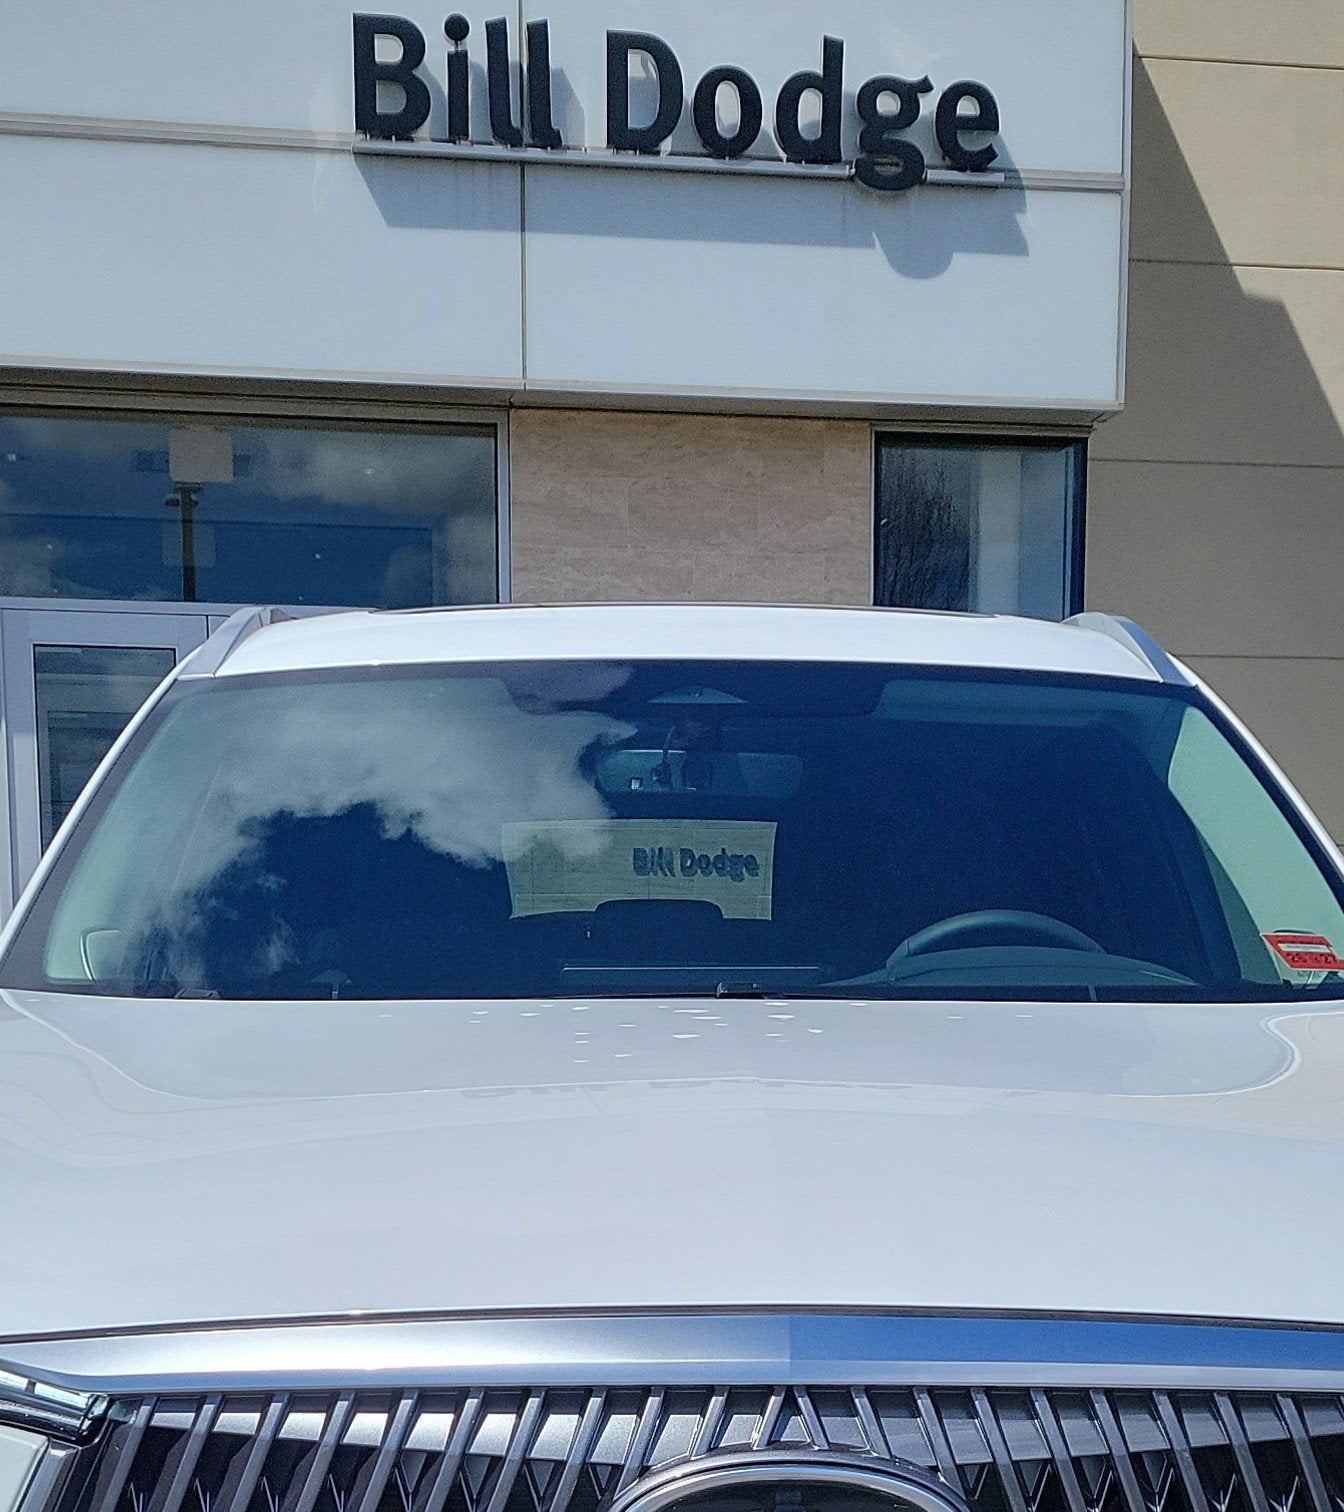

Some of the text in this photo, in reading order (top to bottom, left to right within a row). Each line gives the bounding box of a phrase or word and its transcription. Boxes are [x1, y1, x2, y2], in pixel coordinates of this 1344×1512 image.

[352, 12, 1000, 192] Bill Dodge
[633, 847, 759, 882] Bill Dodge
